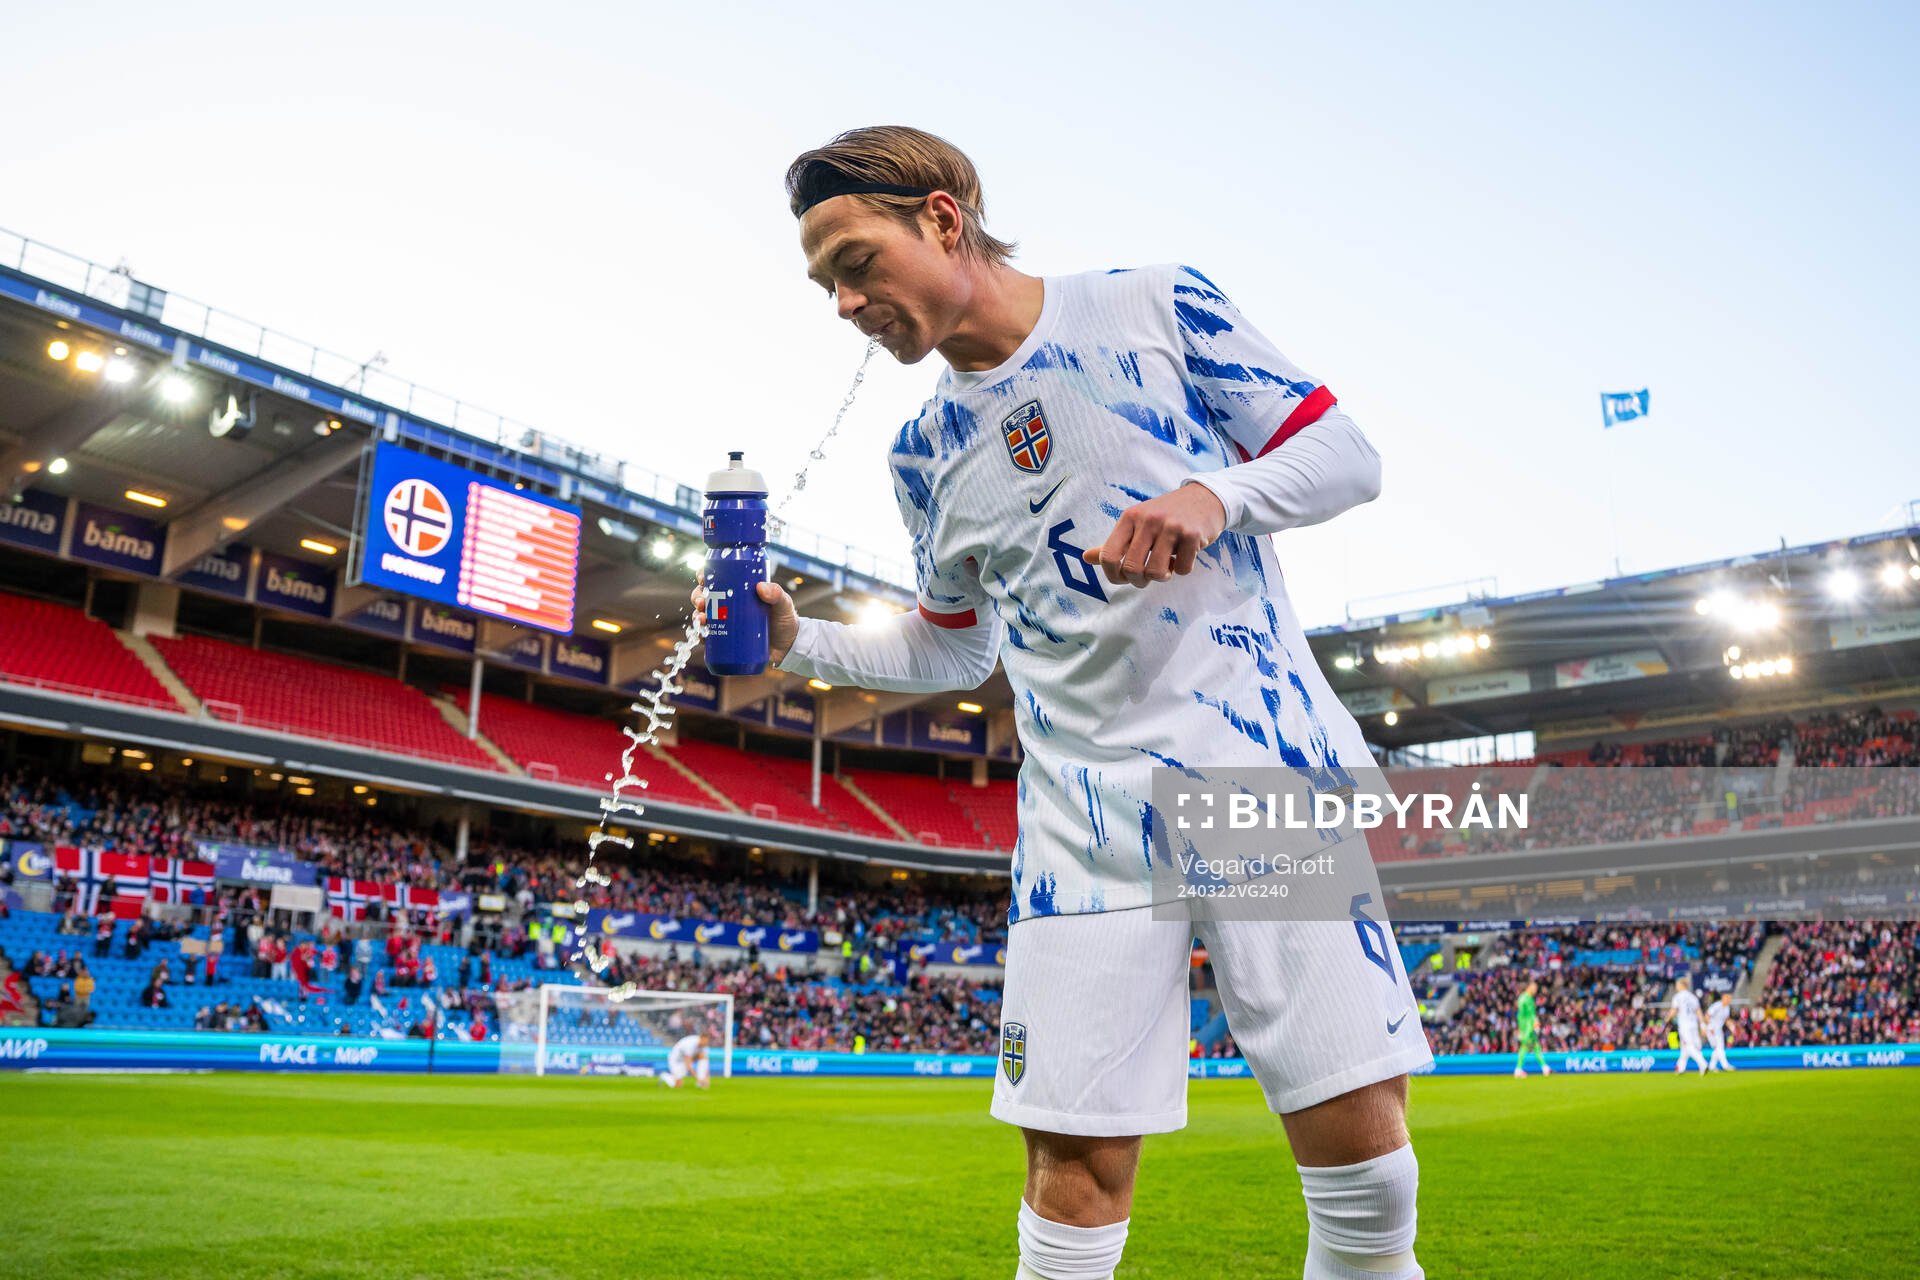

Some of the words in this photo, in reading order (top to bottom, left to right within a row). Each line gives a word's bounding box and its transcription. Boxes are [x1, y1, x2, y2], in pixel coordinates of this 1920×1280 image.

[83, 520, 155, 561] bama
[1048, 519, 1109, 604] 6
[266, 567, 327, 604] bama
[421, 607, 475, 641] bama
[557, 643, 603, 673] bama
[928, 721, 972, 744] bama
[241, 859, 293, 882] bama
[1349, 892, 1397, 986] 6
[260, 1043, 318, 1064] PEACE
[335, 1046, 378, 1064] МИР
[1566, 1056, 1608, 1071] PEACE
[1622, 1056, 1655, 1071] МИР
[1803, 1051, 1850, 1067] PEACE
[1867, 1049, 1905, 1065] МИР
